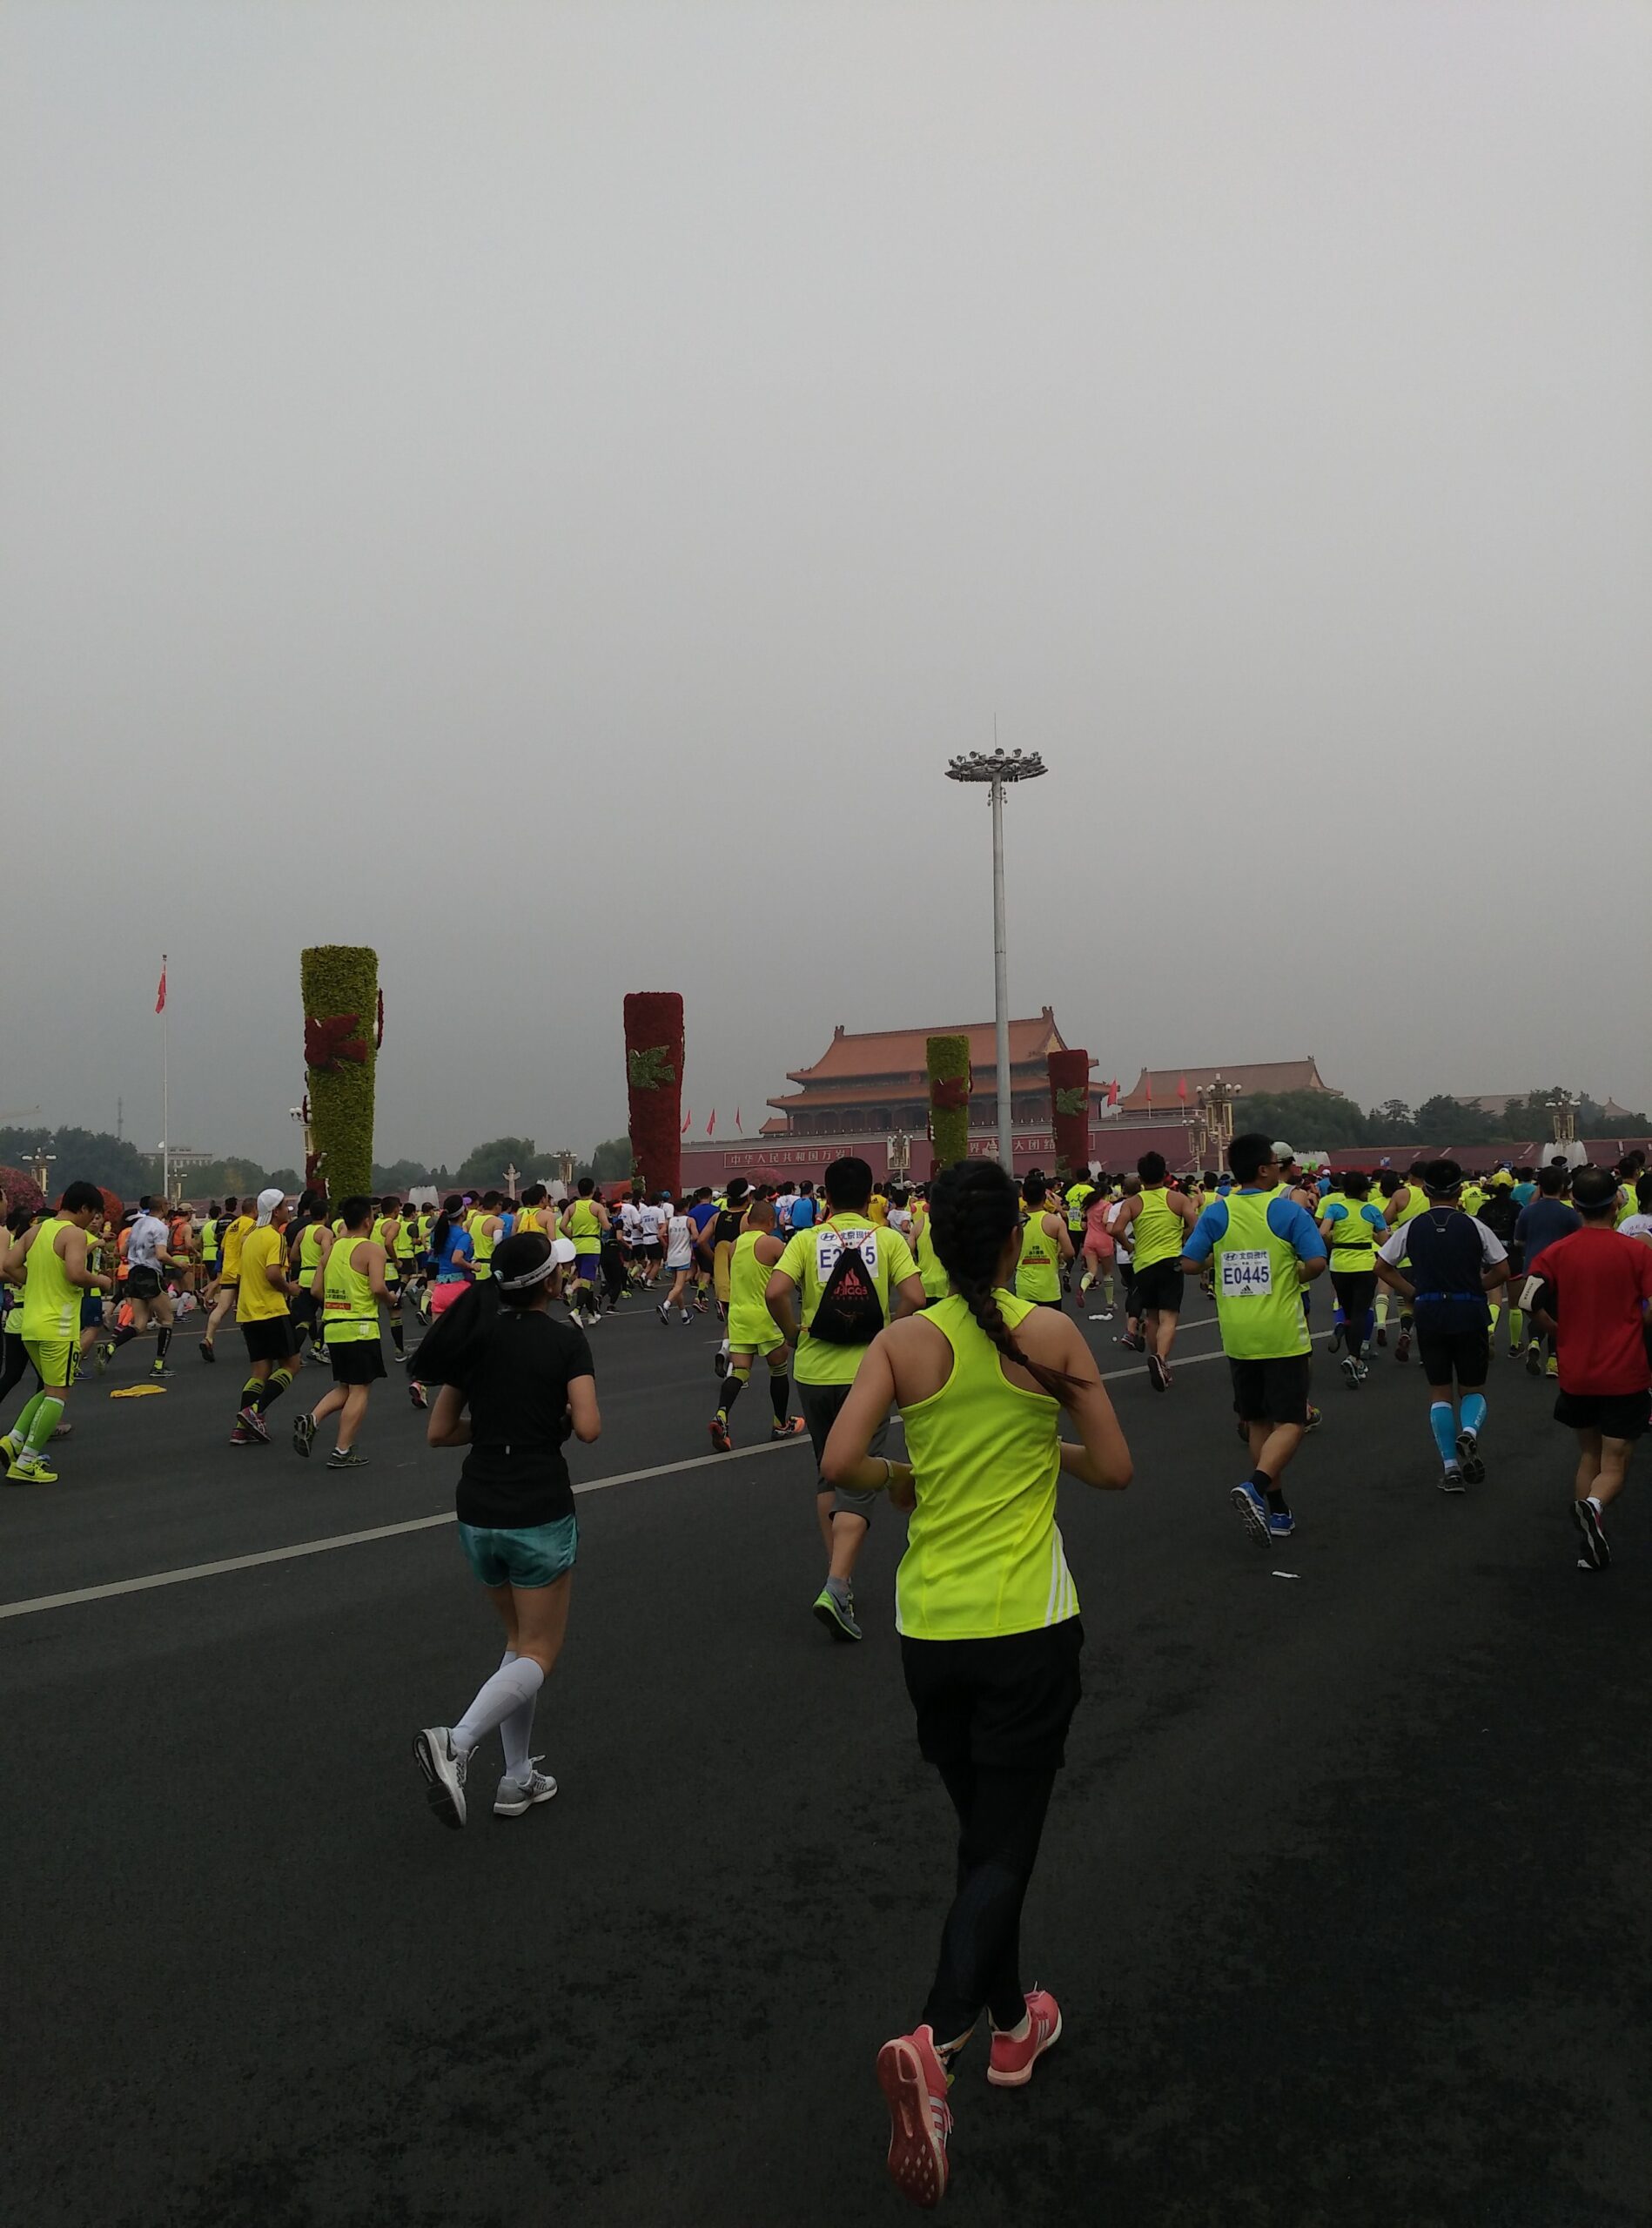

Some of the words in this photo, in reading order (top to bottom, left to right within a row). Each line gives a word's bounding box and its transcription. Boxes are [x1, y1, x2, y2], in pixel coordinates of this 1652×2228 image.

[731, 1150, 845, 1164] 中华人民共和国万岁
[820, 1246, 875, 1268] E25
[1224, 1266, 1269, 1285] E0445
